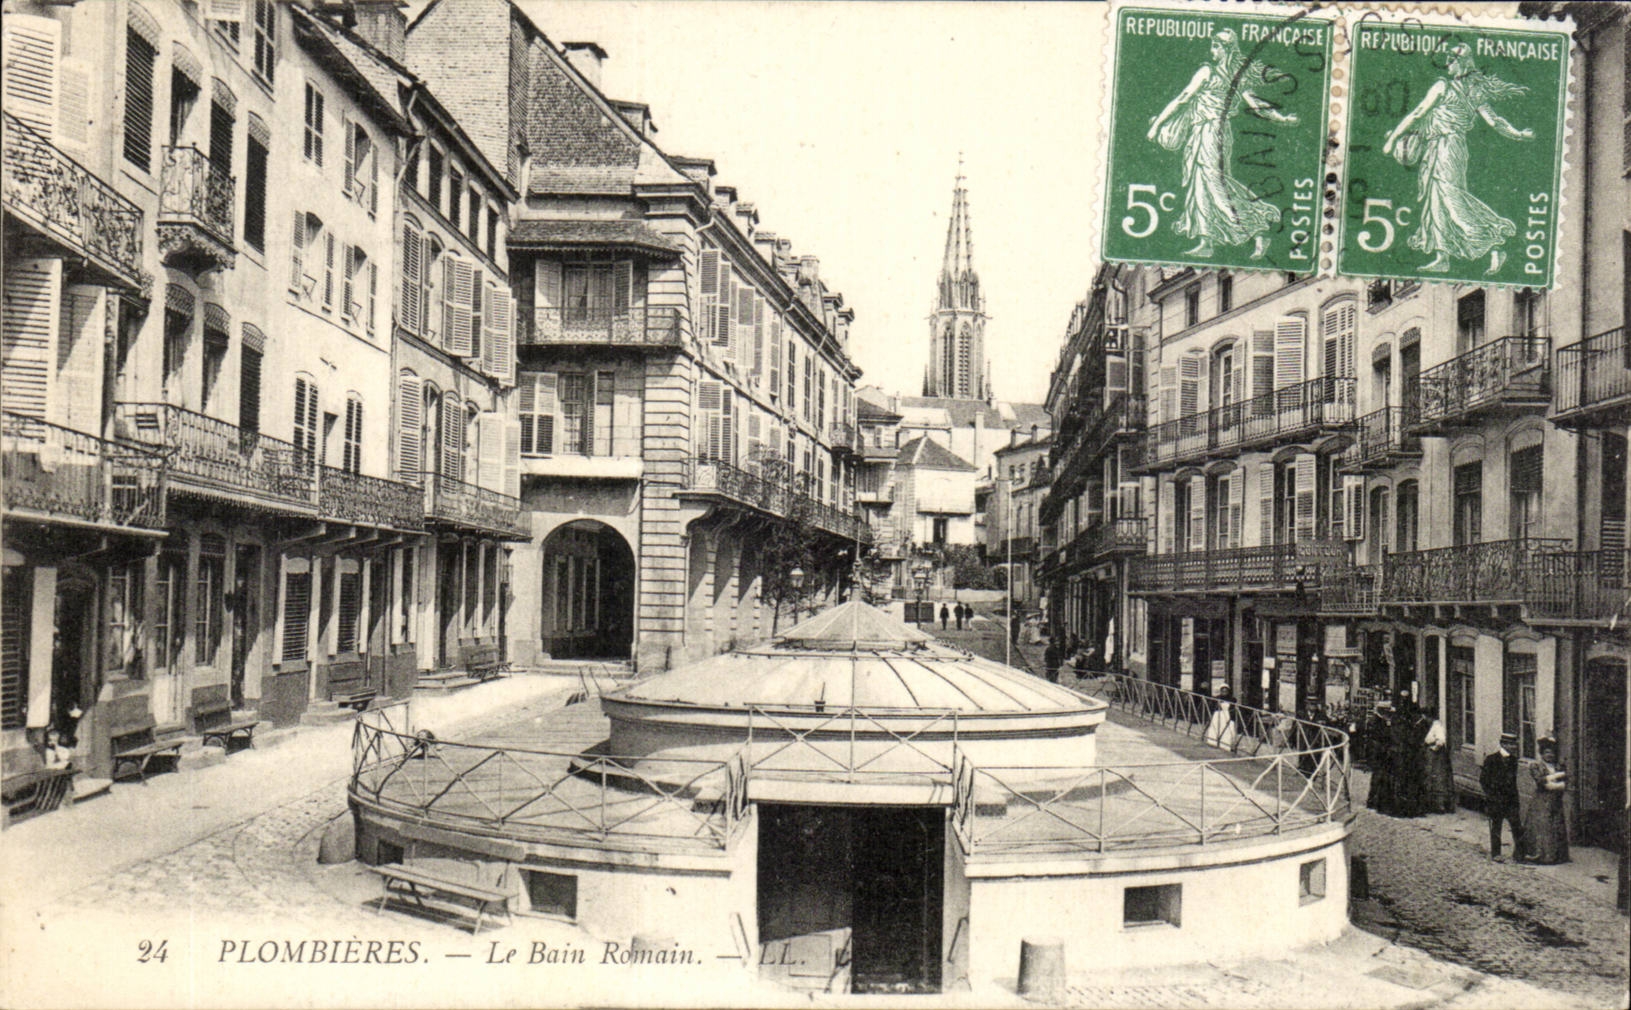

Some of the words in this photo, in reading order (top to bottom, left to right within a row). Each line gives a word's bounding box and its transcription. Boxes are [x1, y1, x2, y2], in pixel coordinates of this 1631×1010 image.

[1241, 23, 1324, 48] FRANÇAISE
[1476, 37, 1559, 61] FRANÇAISE
[1289, 177, 1314, 260] POSTES
[1523, 191, 1550, 275] POSTES
